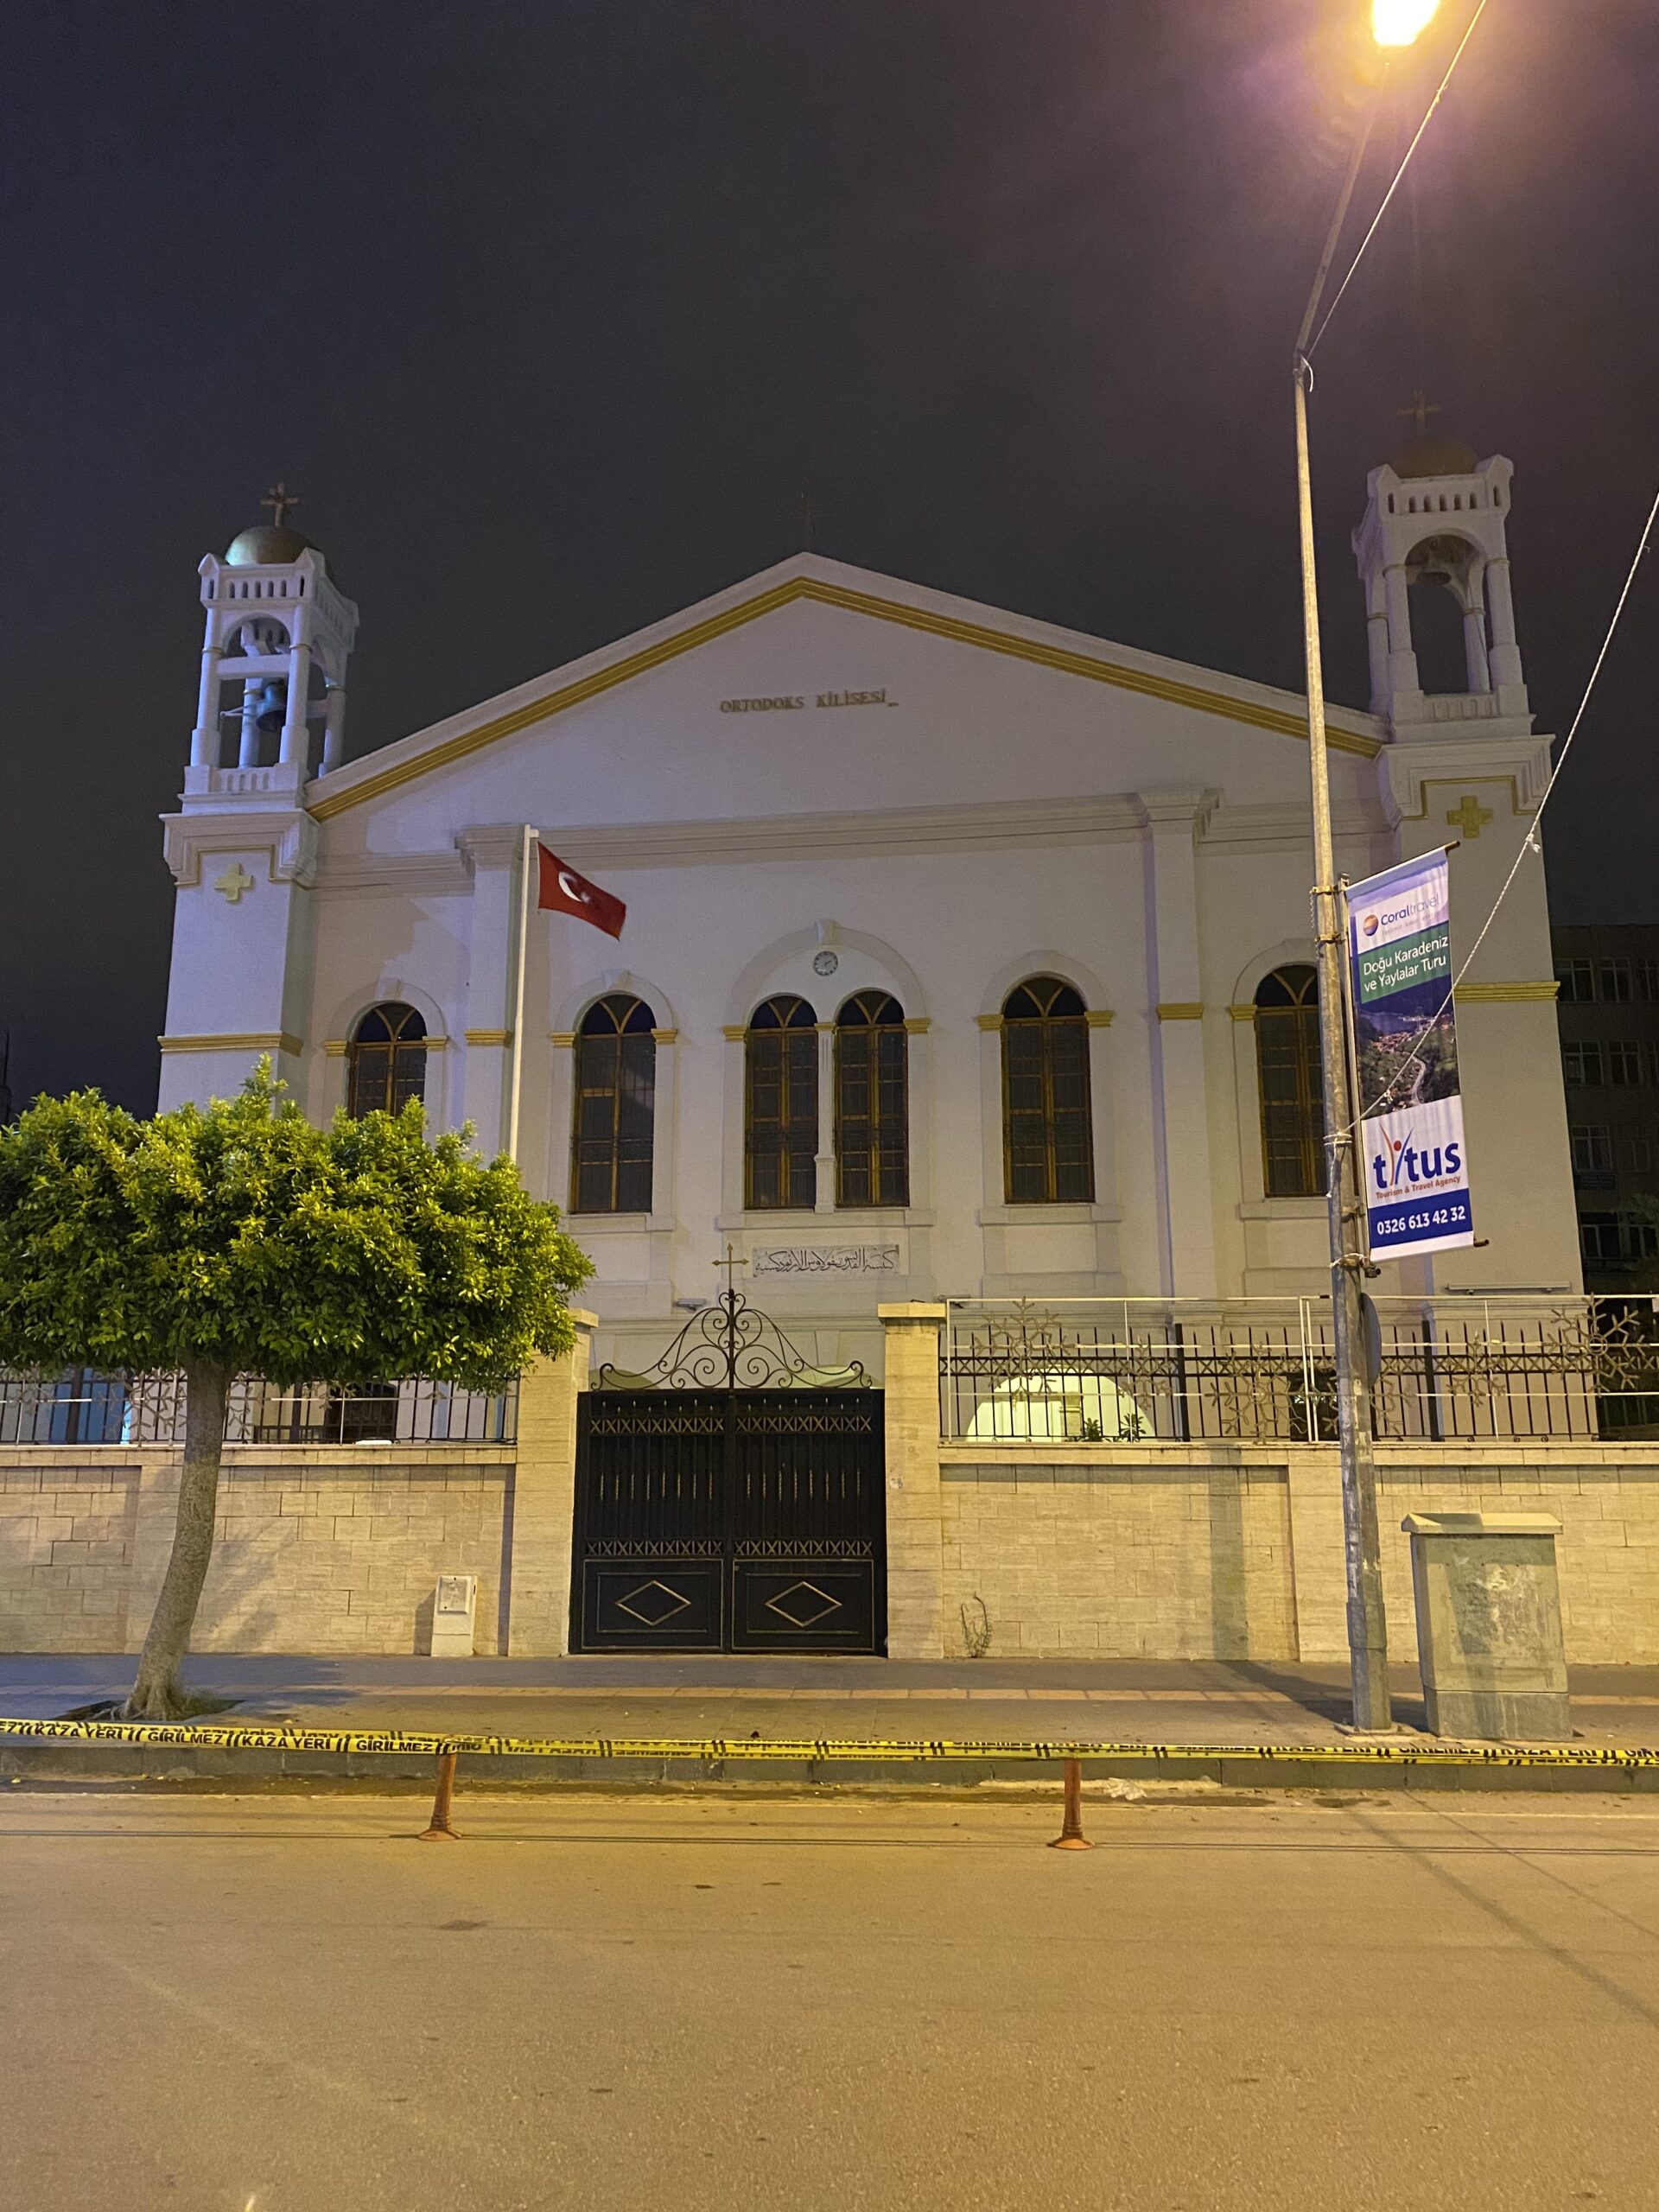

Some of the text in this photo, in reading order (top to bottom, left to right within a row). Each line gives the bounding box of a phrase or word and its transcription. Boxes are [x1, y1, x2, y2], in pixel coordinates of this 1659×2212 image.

[720, 696, 804, 713] ORTODOKS
[1363, 936, 1449, 976] Doğu Karadeniz
[1363, 955, 1446, 992] ve Yaylalar Turu
[1376, 1176, 1461, 1199] Tourism & Travel Agency
[1376, 1205, 1466, 1235] 0326 613 42 32
[35, 1726, 80, 1737] KAZA
[242, 1735, 289, 1747] KAZA
